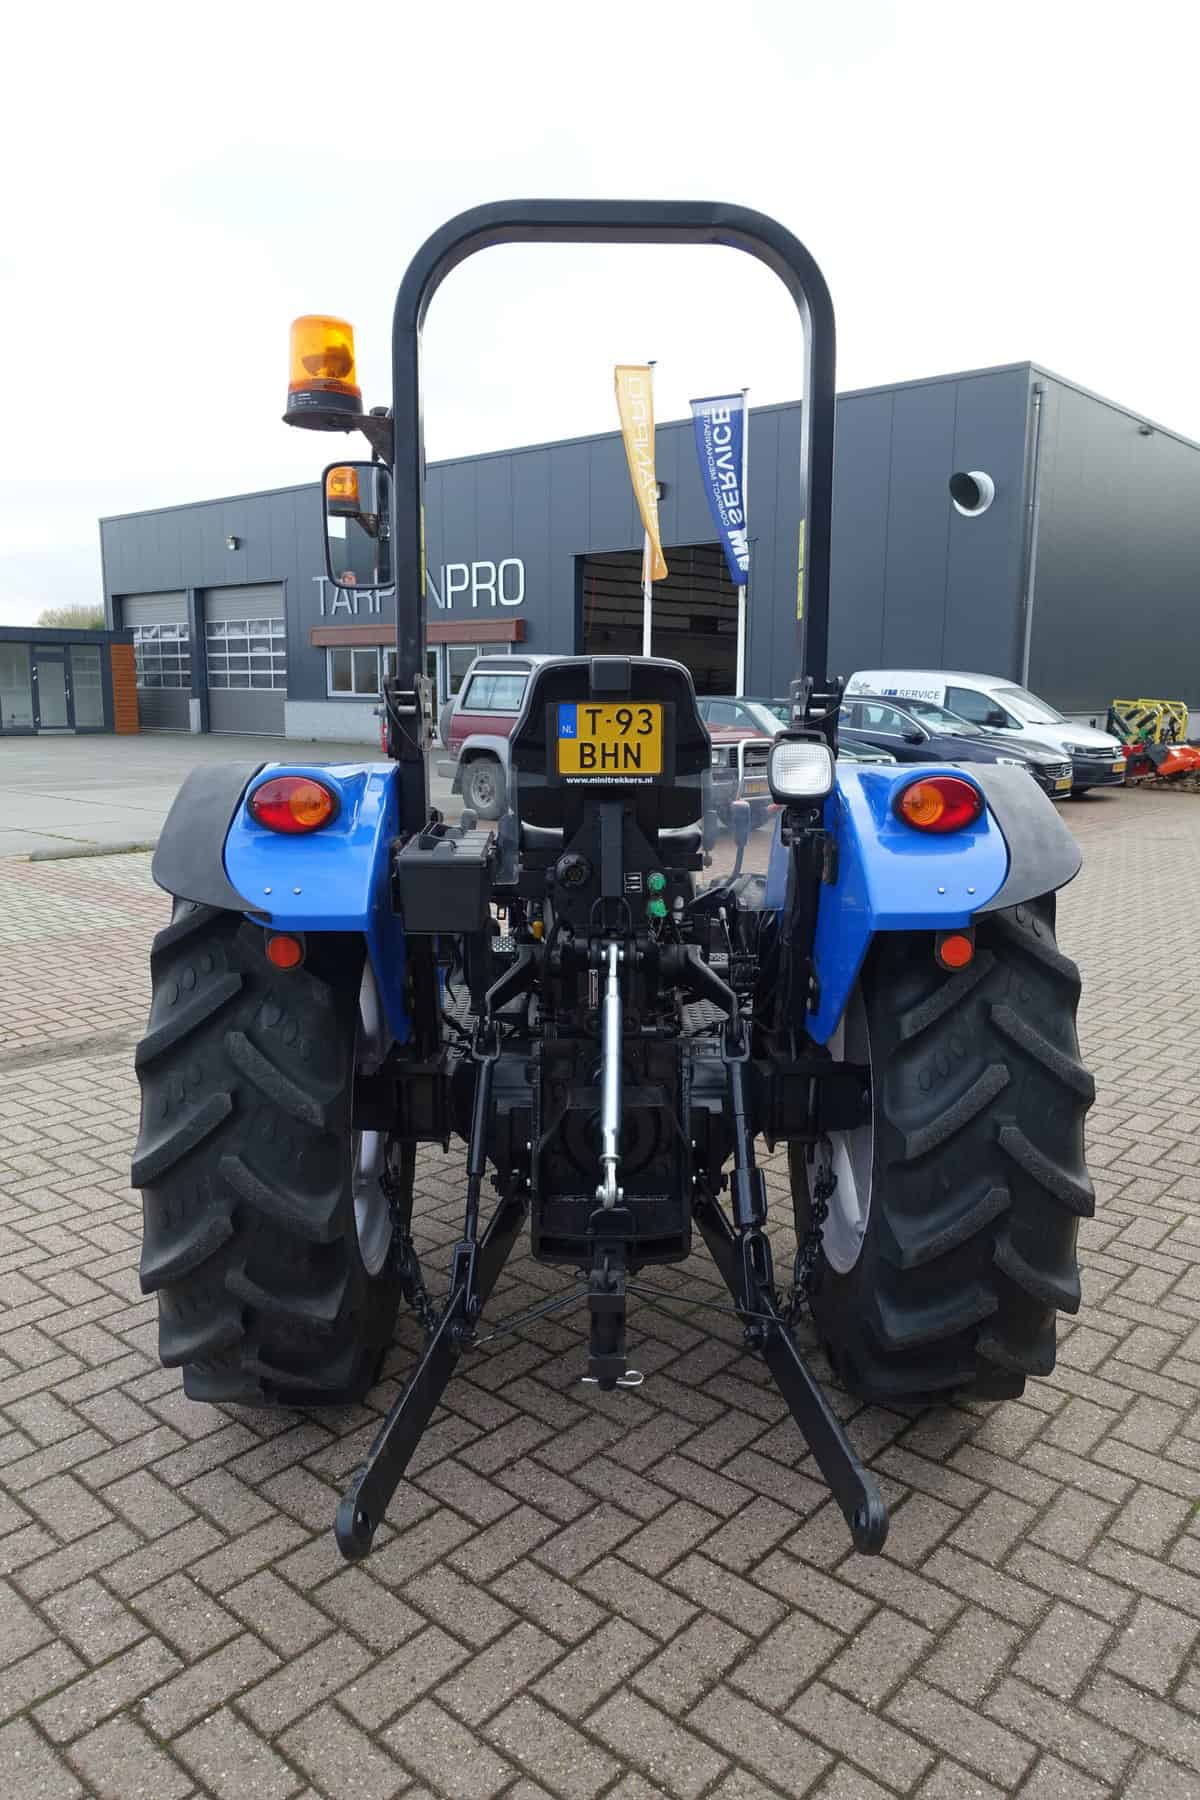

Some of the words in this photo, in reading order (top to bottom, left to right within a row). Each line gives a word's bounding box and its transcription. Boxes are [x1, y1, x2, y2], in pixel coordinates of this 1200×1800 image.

[312, 558, 525, 616] TARPNPRO
[899, 688, 941, 699] SERVICE
[561, 724, 574, 734] NL
[585, 708, 653, 735] T-93
[579, 742, 641, 769] BHN
[566, 776, 653, 784] www.minitrekkers.nl
